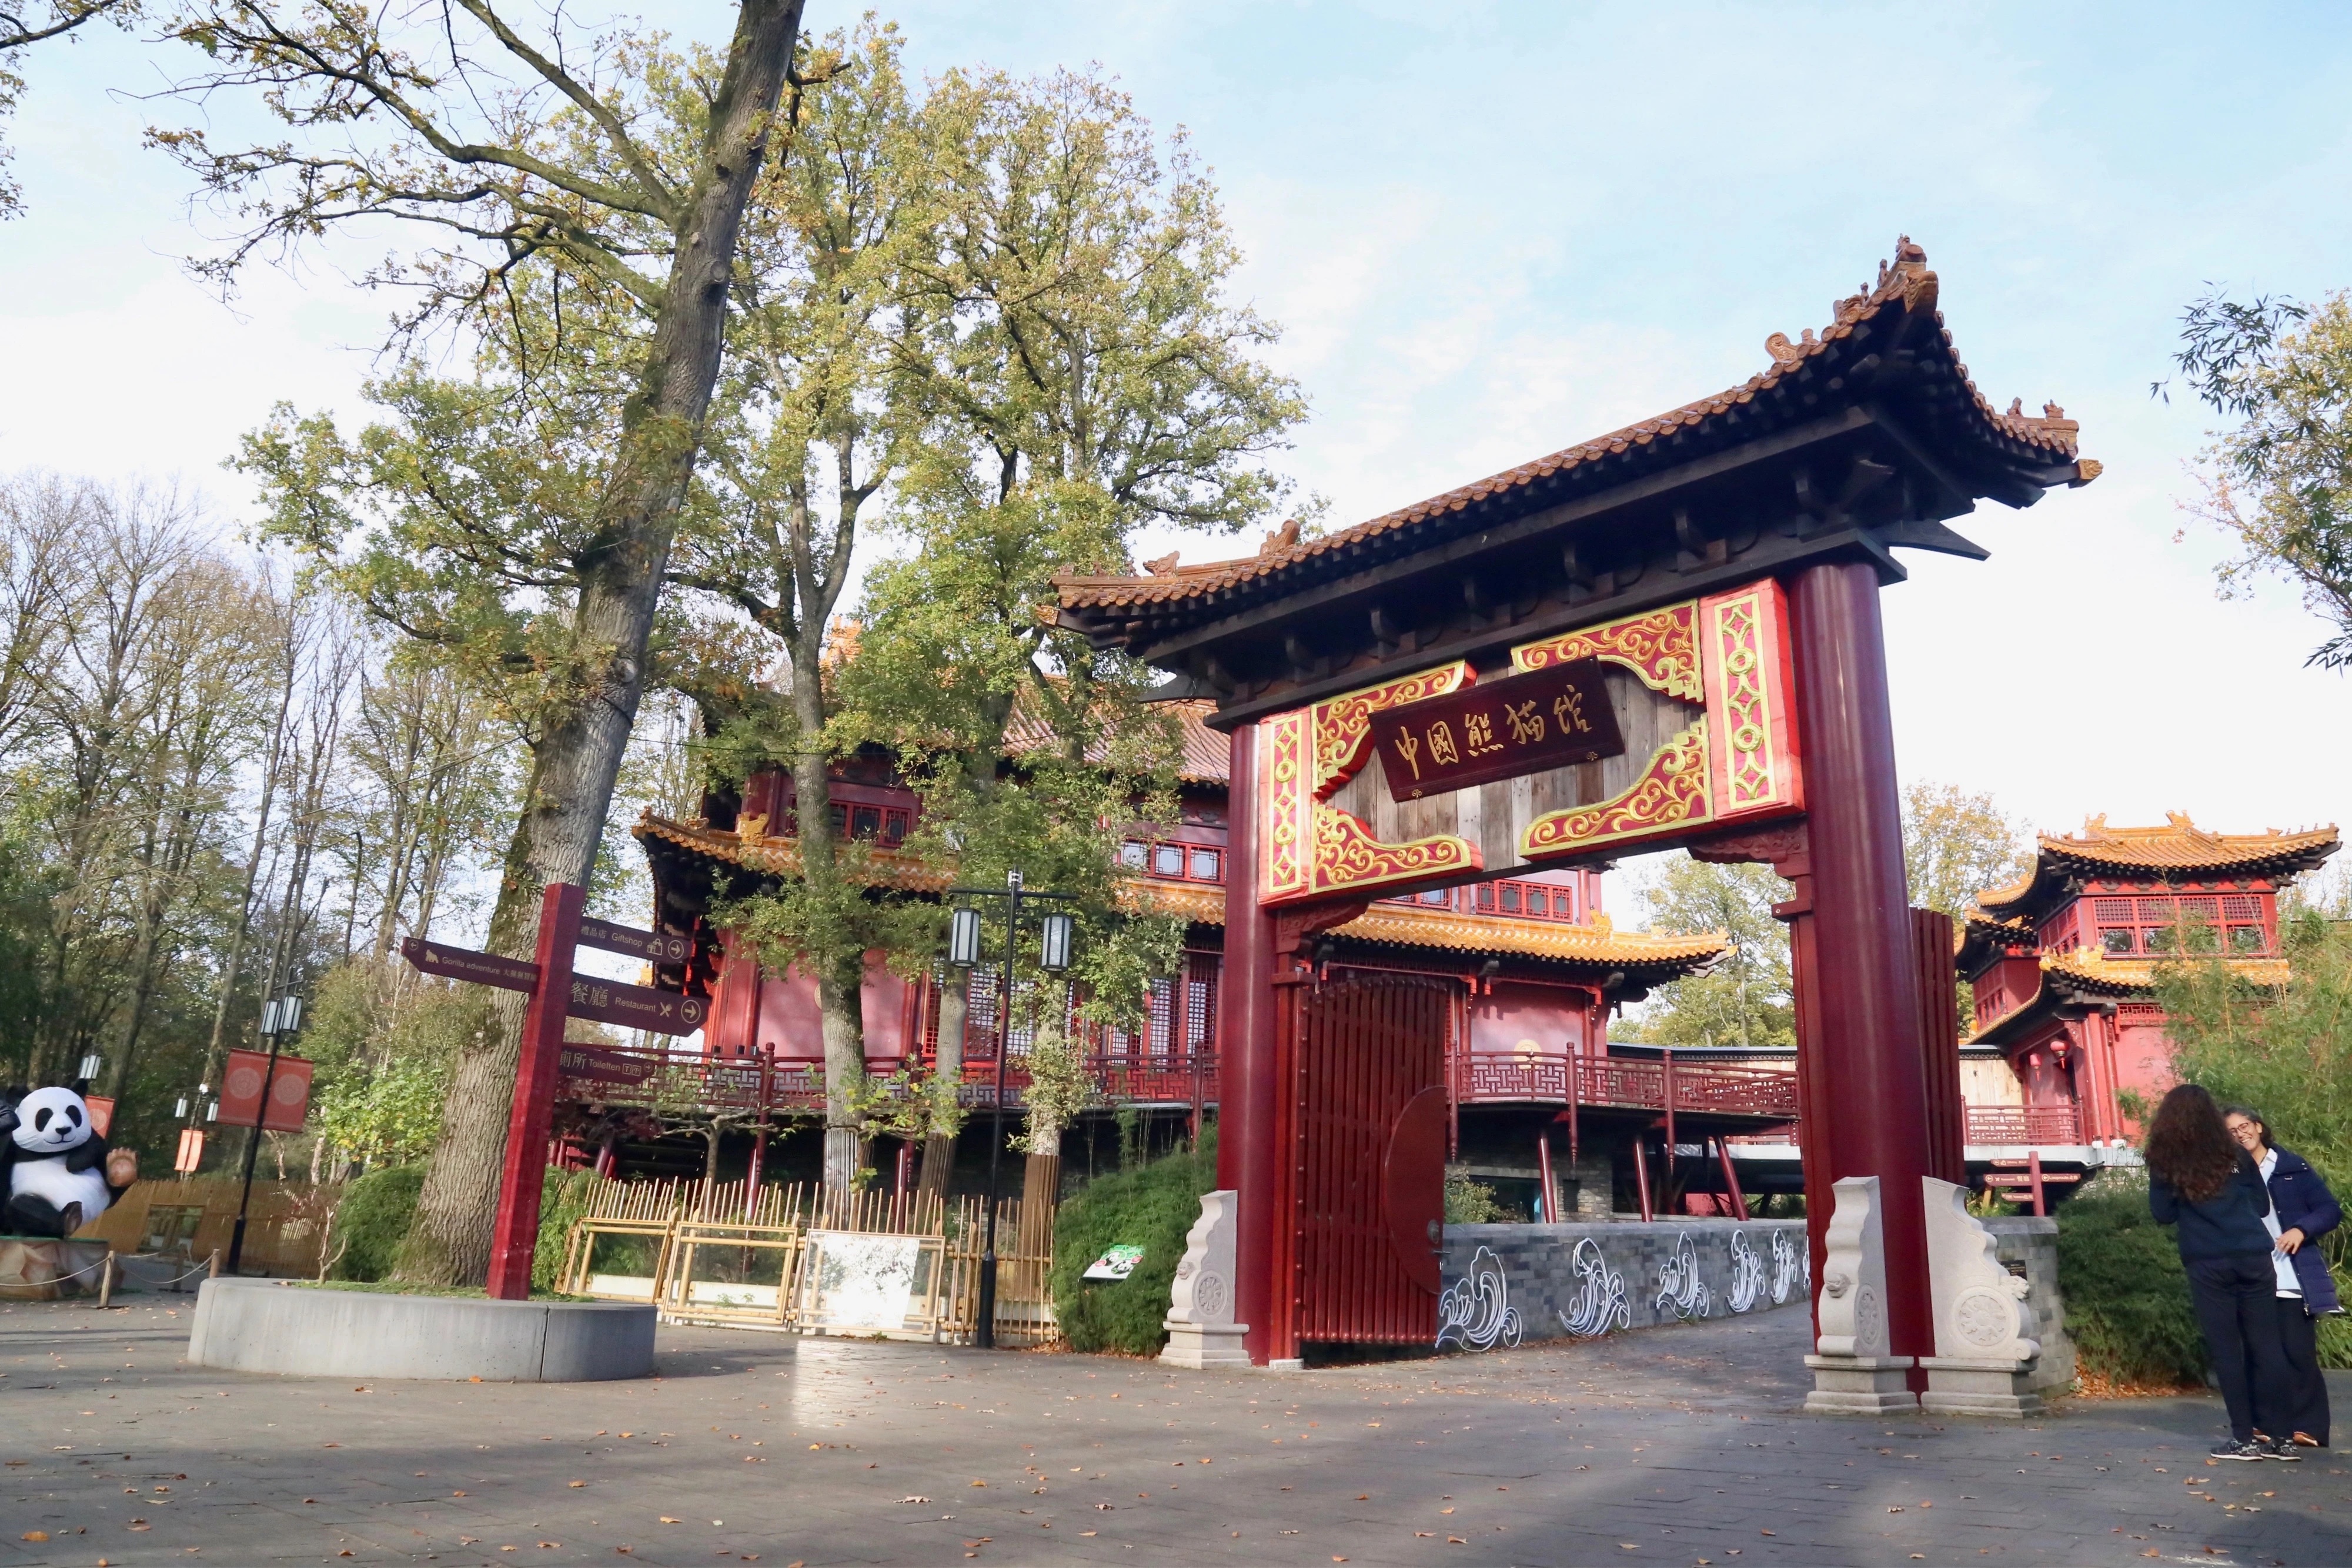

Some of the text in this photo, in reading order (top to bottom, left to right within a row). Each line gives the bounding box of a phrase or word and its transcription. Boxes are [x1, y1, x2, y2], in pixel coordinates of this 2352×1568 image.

[612, 932, 643, 947] Giftshop
[442, 957, 465, 968] Gorilla
[466, 962, 500, 974] adventure
[570, 981, 656, 1012] 餐廳 Restaurant
[589, 1058, 621, 1072] Toiletten
